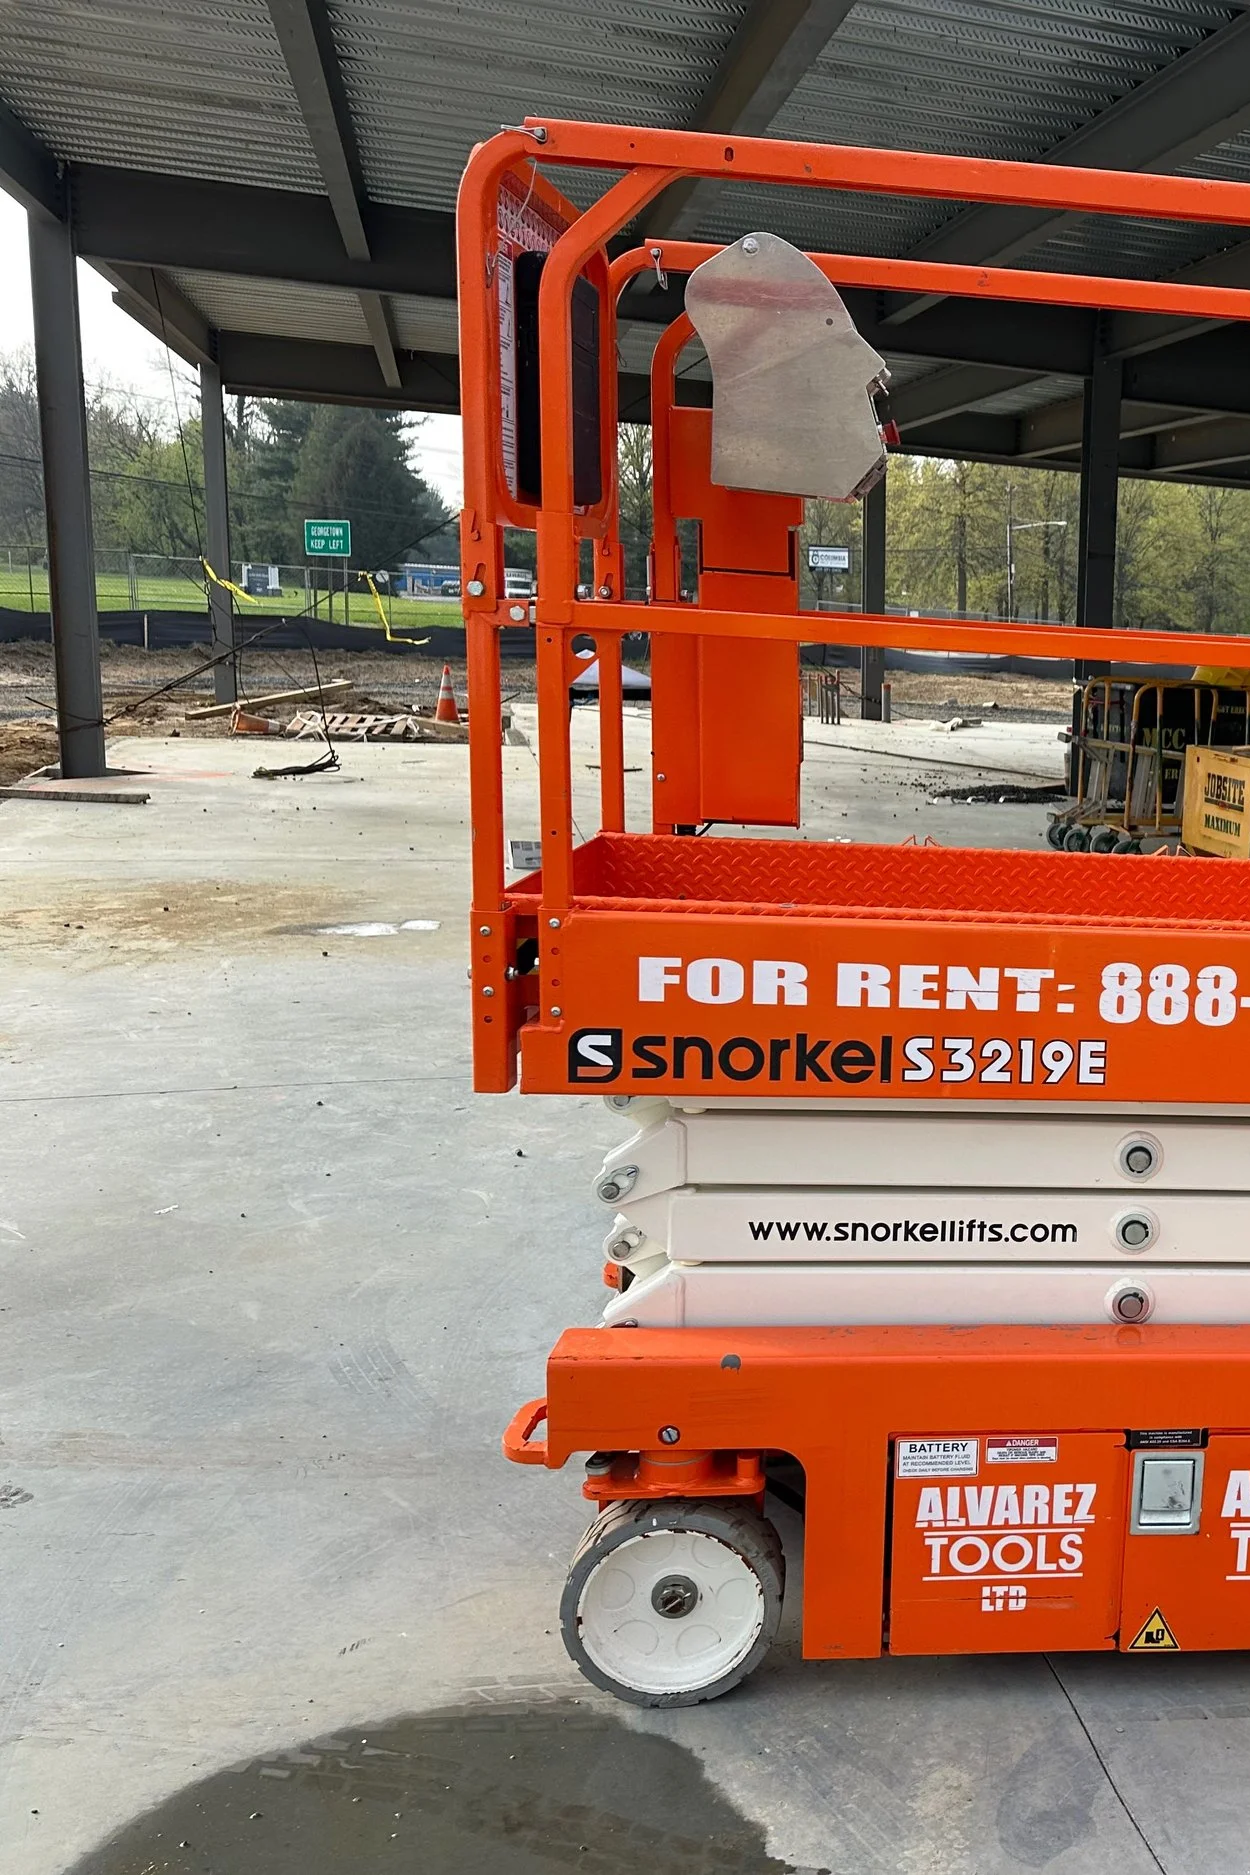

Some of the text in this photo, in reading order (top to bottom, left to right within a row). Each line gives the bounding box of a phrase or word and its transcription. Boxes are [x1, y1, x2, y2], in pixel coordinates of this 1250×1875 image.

[310, 526, 343, 536] GEORGETOWN
[310, 539, 343, 550] KEEP LEFT
[1204, 772, 1245, 806] JOBSITE
[1204, 814, 1241, 837] MAXIMUM
[638, 956, 808, 1006] FOR
[836, 962, 1076, 1014] RENT:
[632, 1033, 893, 1083] snorkel
[902, 1035, 1108, 1085] S3219E
[748, 1219, 1078, 1243] www.snorkellifts.com
[909, 1442, 968, 1453] BATTERY
[1012, 1439, 1039, 1447] DANGER
[914, 1483, 1097, 1528] ALVAREZ
[924, 1533, 1083, 1574] TOOLS
[981, 1585, 1027, 1612] LTD
